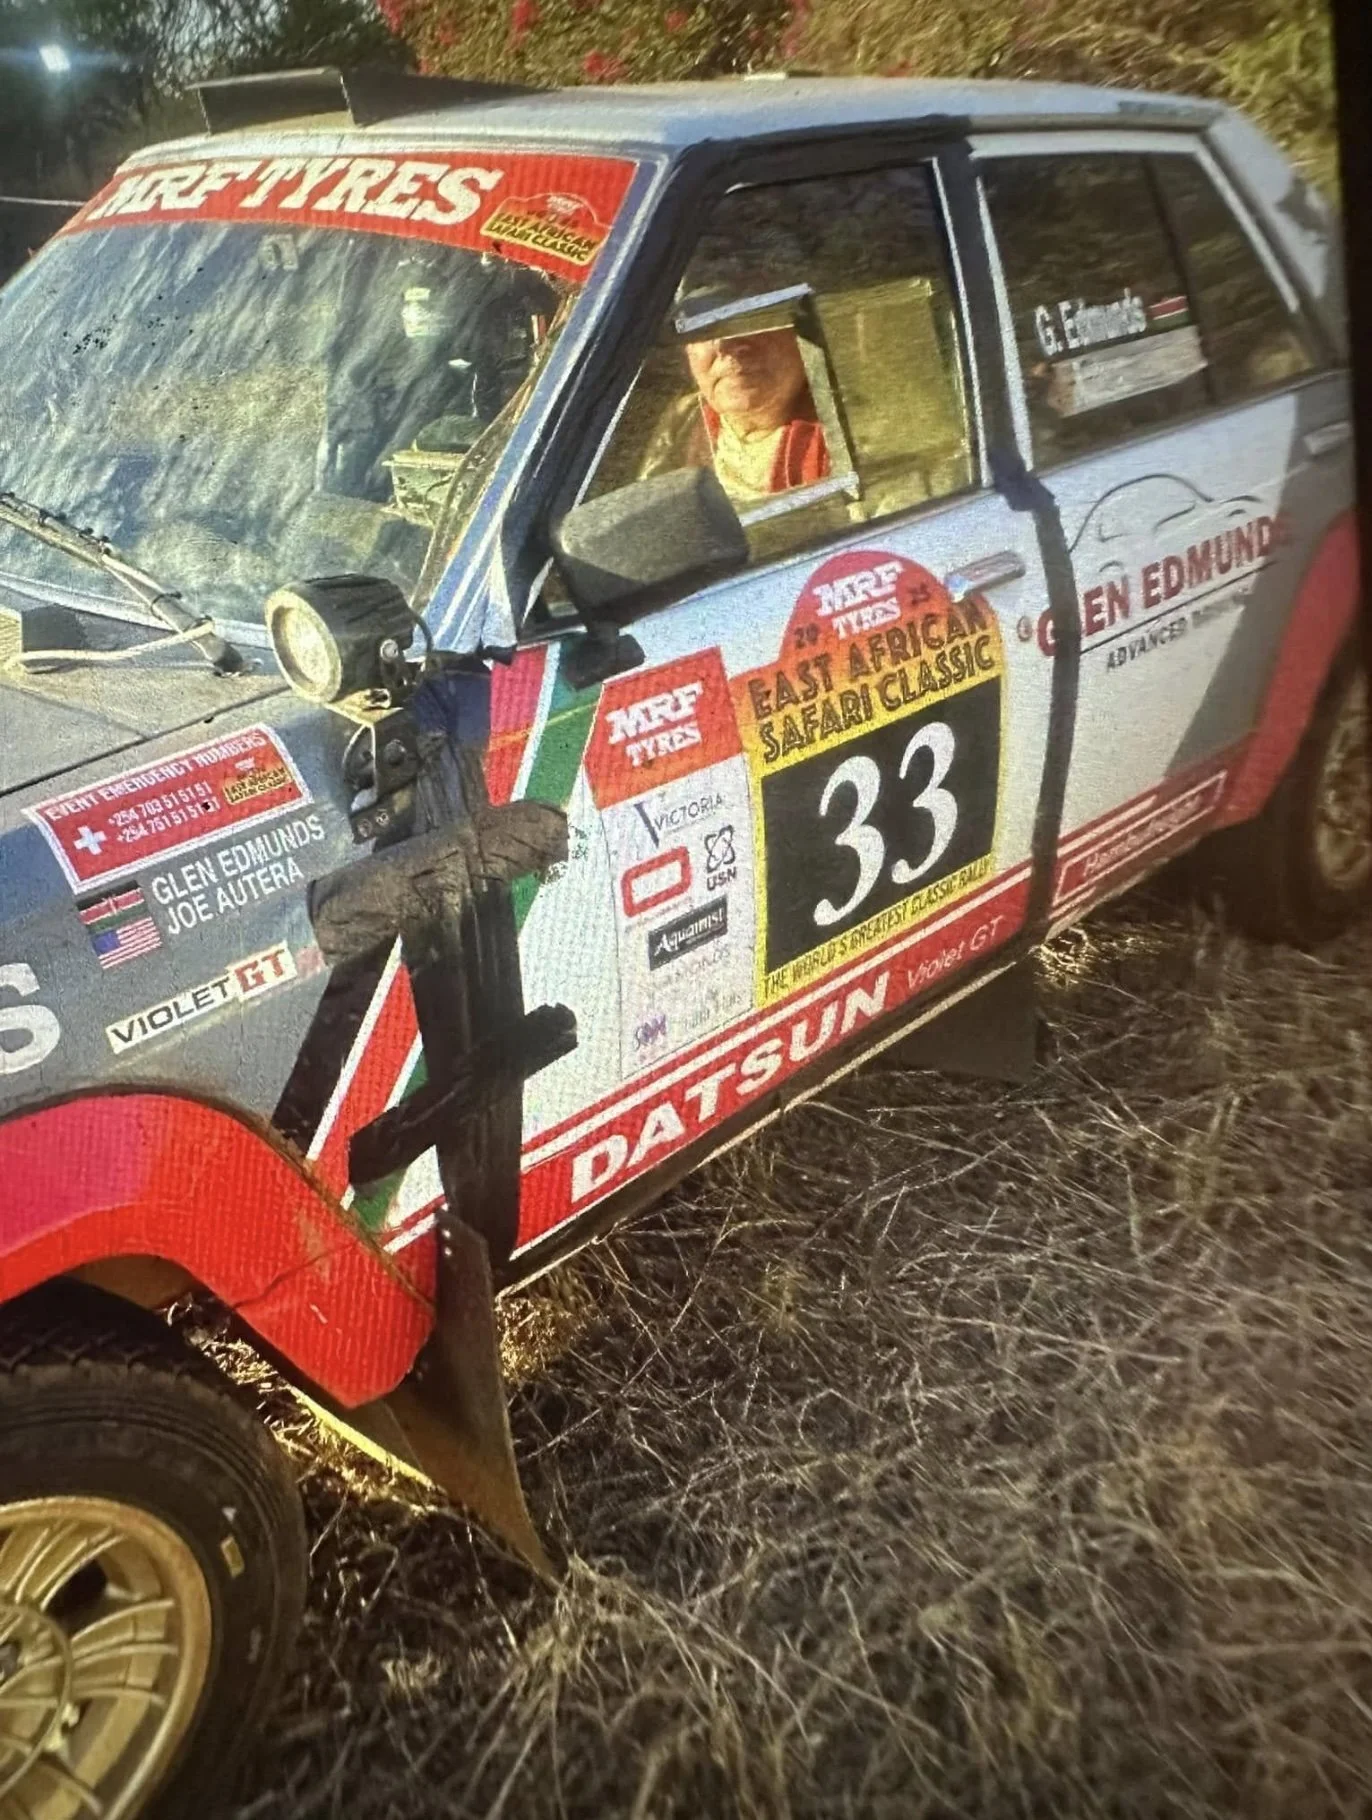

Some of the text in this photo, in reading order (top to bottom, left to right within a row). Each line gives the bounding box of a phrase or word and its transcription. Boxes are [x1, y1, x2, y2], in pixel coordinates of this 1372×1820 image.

[86, 157, 503, 226] MRF TYRES
[812, 560, 904, 617] MRF
[831, 597, 902, 640] TYRES
[1037, 574, 1131, 658] GEN
[748, 599, 988, 720] EAST AFRICAN
[758, 634, 996, 764] SAFARI CLASSIC
[605, 680, 704, 745] MRF
[625, 720, 703, 768] TYRES
[44, 790, 103, 821] EVENT
[99, 761, 195, 801] EMERGENCY
[192, 731, 268, 769] NUMBERS
[654, 792, 722, 832] VICTORIA
[152, 814, 326, 905] GLEN EDMUNDS
[812, 721, 958, 927] 33
[168, 856, 304, 935] JOE AUTERA
[706, 866, 737, 891] USN
[764, 972, 789, 997] THE
[849, 901, 909, 951] GREATEST
[910, 874, 958, 916] CLASSIC
[111, 947, 288, 1045] VIOLET GT
[570, 970, 890, 1205] DATSUN
[907, 938, 965, 990] Violet
[969, 914, 1004, 952] GT
